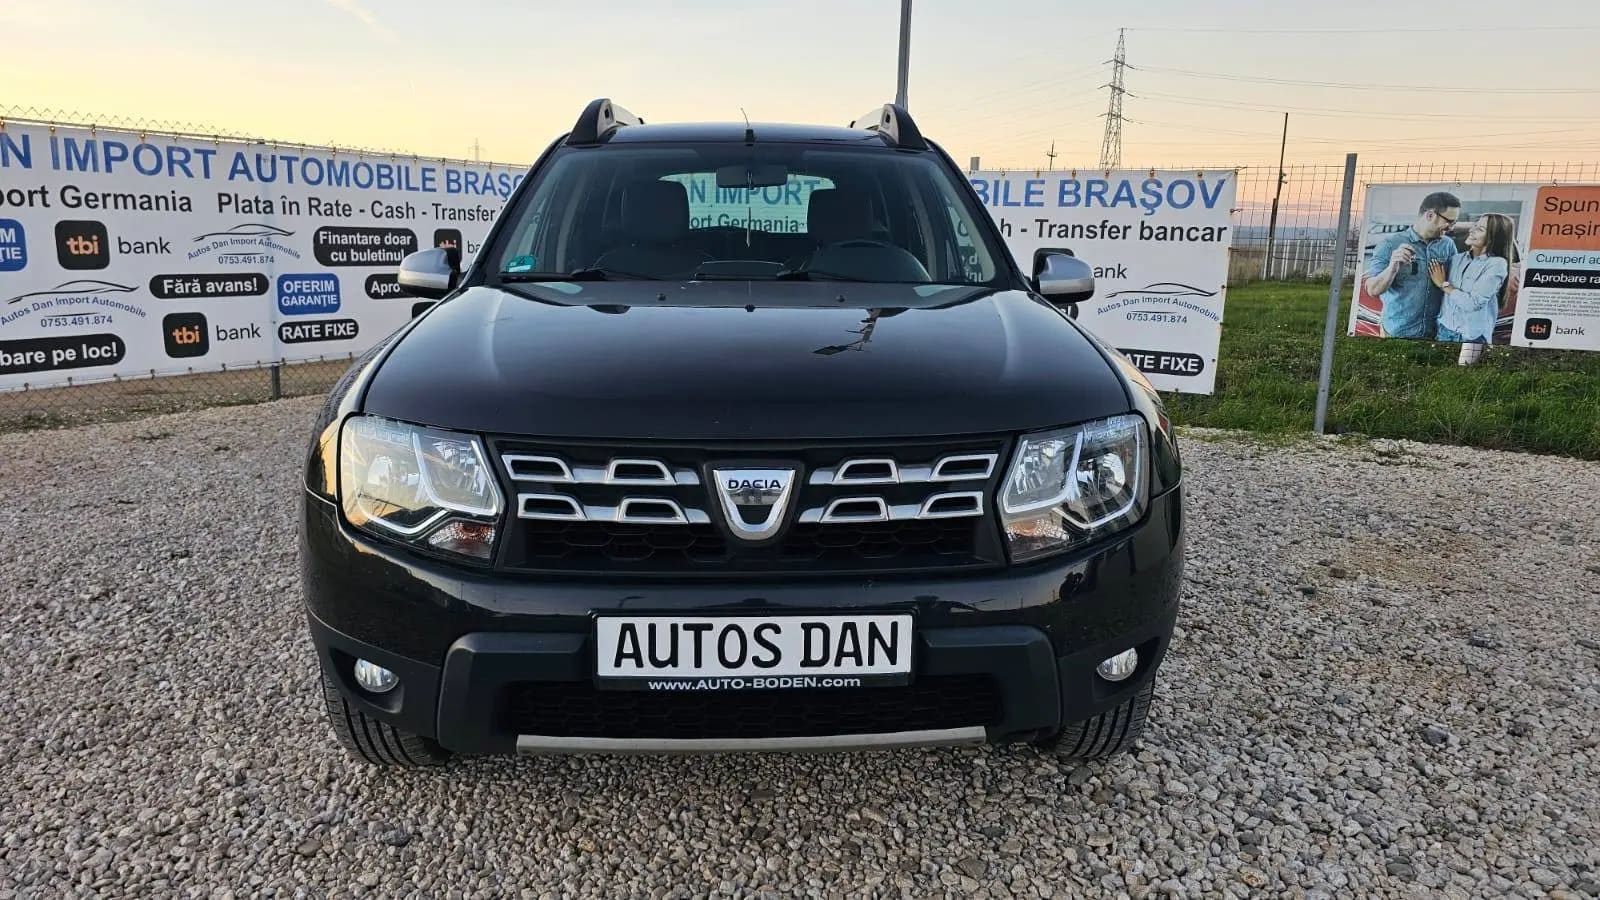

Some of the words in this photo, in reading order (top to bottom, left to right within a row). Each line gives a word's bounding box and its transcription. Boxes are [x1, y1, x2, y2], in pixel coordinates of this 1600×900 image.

[50, 136, 216, 180] IMPORT
[228, 151, 438, 193] AUTOMOBILE
[60, 185, 193, 212] Germania
[217, 192, 275, 215] Plata
[281, 195, 300, 215] în
[308, 197, 352, 218] Rate
[371, 201, 416, 220] Cash
[432, 203, 496, 221] Transfer
[319, 231, 381, 246] Finantare
[384, 232, 412, 245] doar
[1035, 218, 1132, 240] Transfer
[1139, 220, 1228, 242] bancar
[66, 235, 99, 256] tbi
[118, 236, 172, 254] bank
[188, 246, 211, 260] Autos
[212, 240, 229, 250] Dan
[230, 238, 257, 246] Import
[258, 237, 301, 259] Automobile
[218, 255, 275, 264] 0753.491.874
[330, 252, 347, 262] cu
[350, 249, 405, 262] buletinul
[1536, 253, 1586, 265] Cumperi
[163, 278, 202, 294] Fără
[206, 277, 258, 292] avans!
[283, 279, 335, 293] OFERIM
[1532, 272, 1587, 284] Aprobare
[1, 308, 31, 326] Autos
[32, 298, 54, 312] Dan
[55, 296, 90, 306] Import
[92, 296, 147, 318] Automobile
[1097, 303, 1121, 315] Autos
[1122, 298, 1140, 306] Dan
[1142, 296, 1171, 305] Import
[1172, 298, 1220, 322] Automobile
[1126, 312, 1188, 323] 0753.491.874
[40, 315, 113, 328] 0753.491.874
[172, 325, 200, 344] tbi
[216, 322, 262, 341] bank
[281, 324, 322, 340] RATE
[325, 322, 357, 337] FIXE
[1529, 325, 1547, 334] tbi
[1555, 326, 1585, 336] bank
[52, 347, 77, 366] pe
[81, 341, 118, 359] loc!
[1159, 356, 1200, 373] FIXE
[728, 479, 781, 489] DACIA
[614, 622, 782, 669] AUTOS
[800, 620, 899, 667] DAN
[648, 676, 861, 690] www.AUTO-BODEN.com
